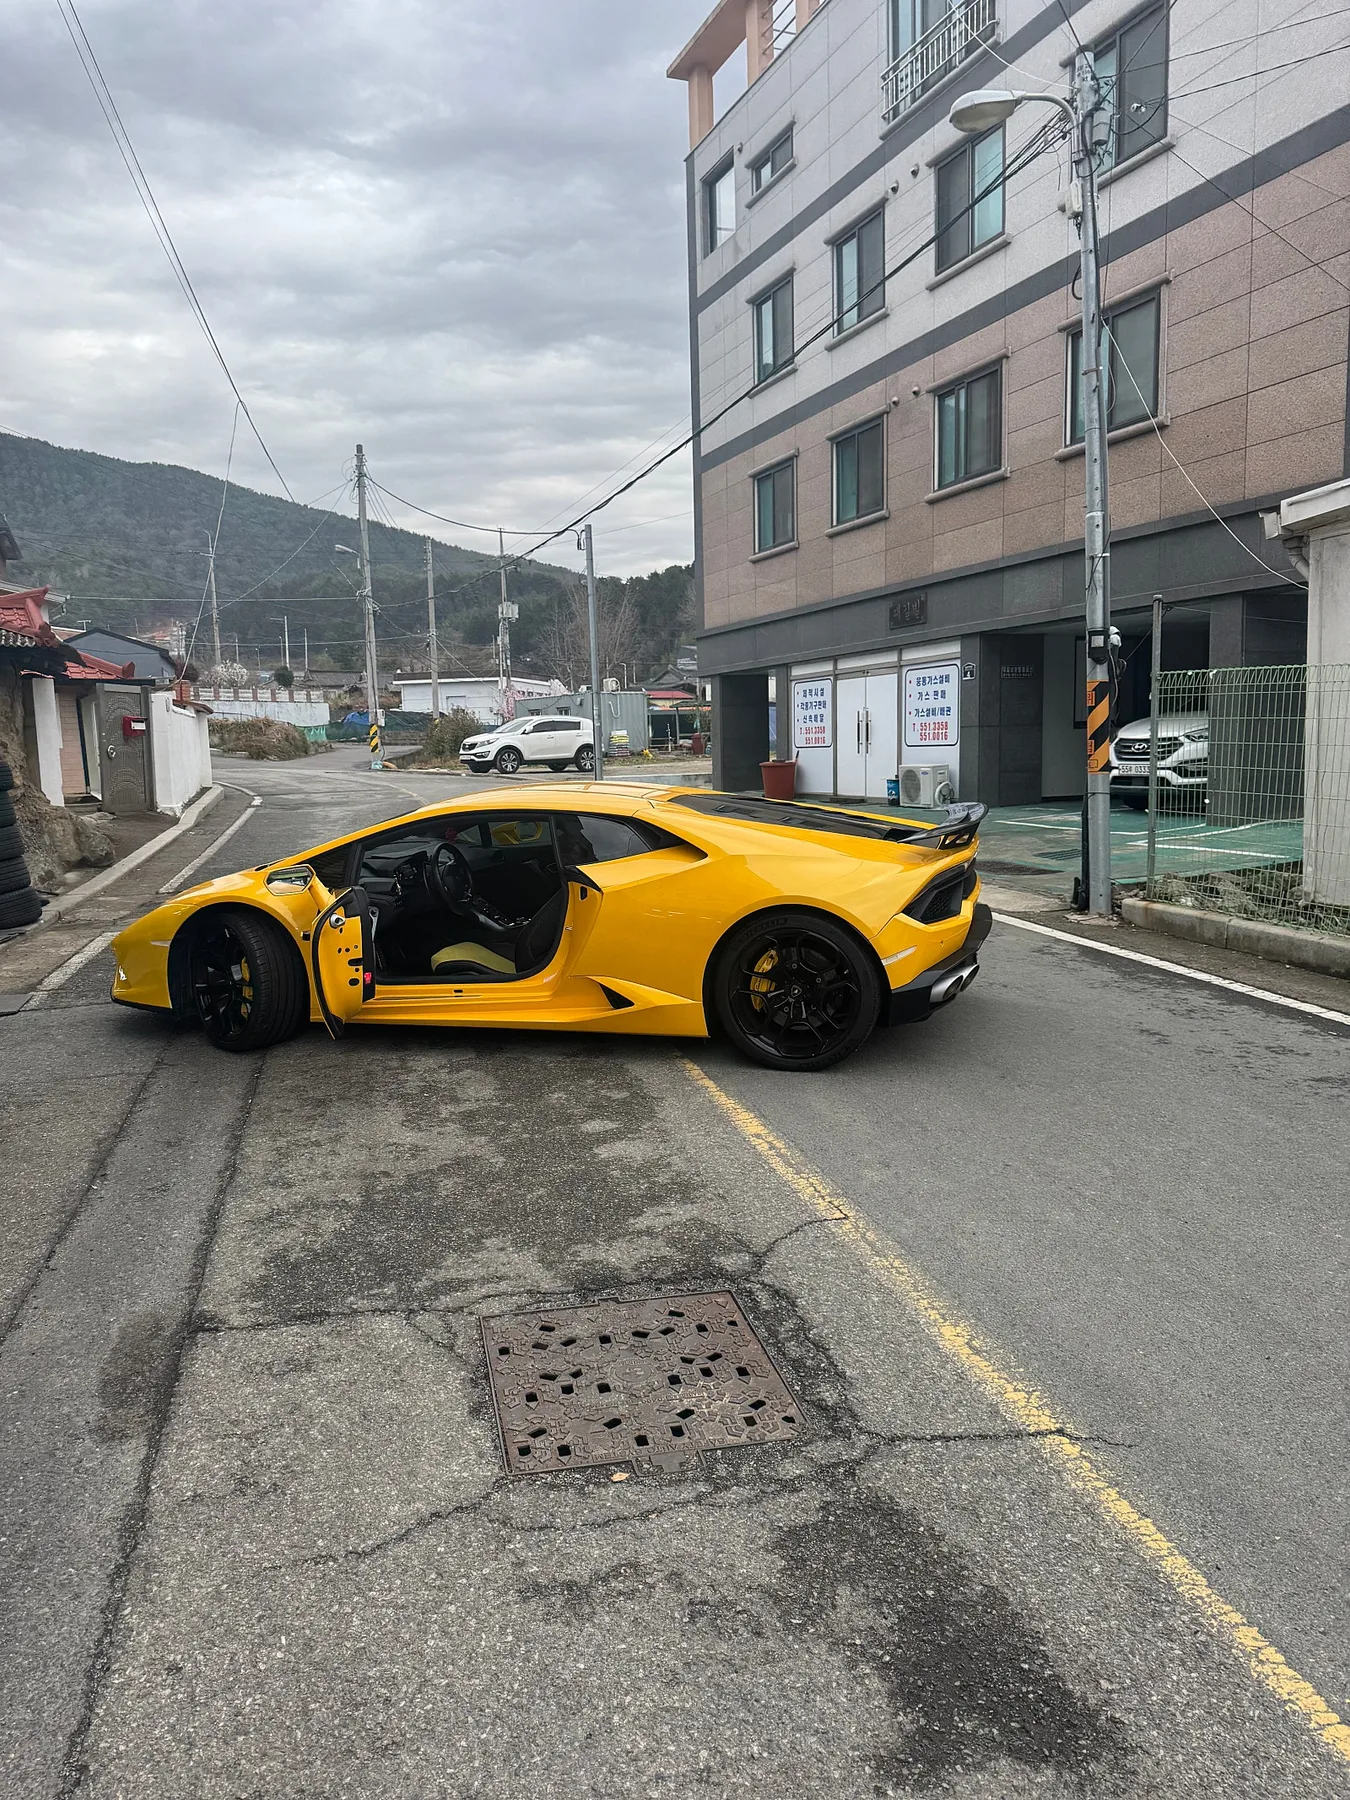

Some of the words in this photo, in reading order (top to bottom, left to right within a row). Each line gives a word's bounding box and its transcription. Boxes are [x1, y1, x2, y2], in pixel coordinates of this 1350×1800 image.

[915, 673, 951, 687] 웅동가스설비
[917, 691, 930, 701] 가스
[933, 689, 947, 700] 판매
[646, 1443, 678, 1454] AUTO
[681, 1437, 726, 1450] SAFETY
[594, 1448, 643, 1461] SYSTEM
